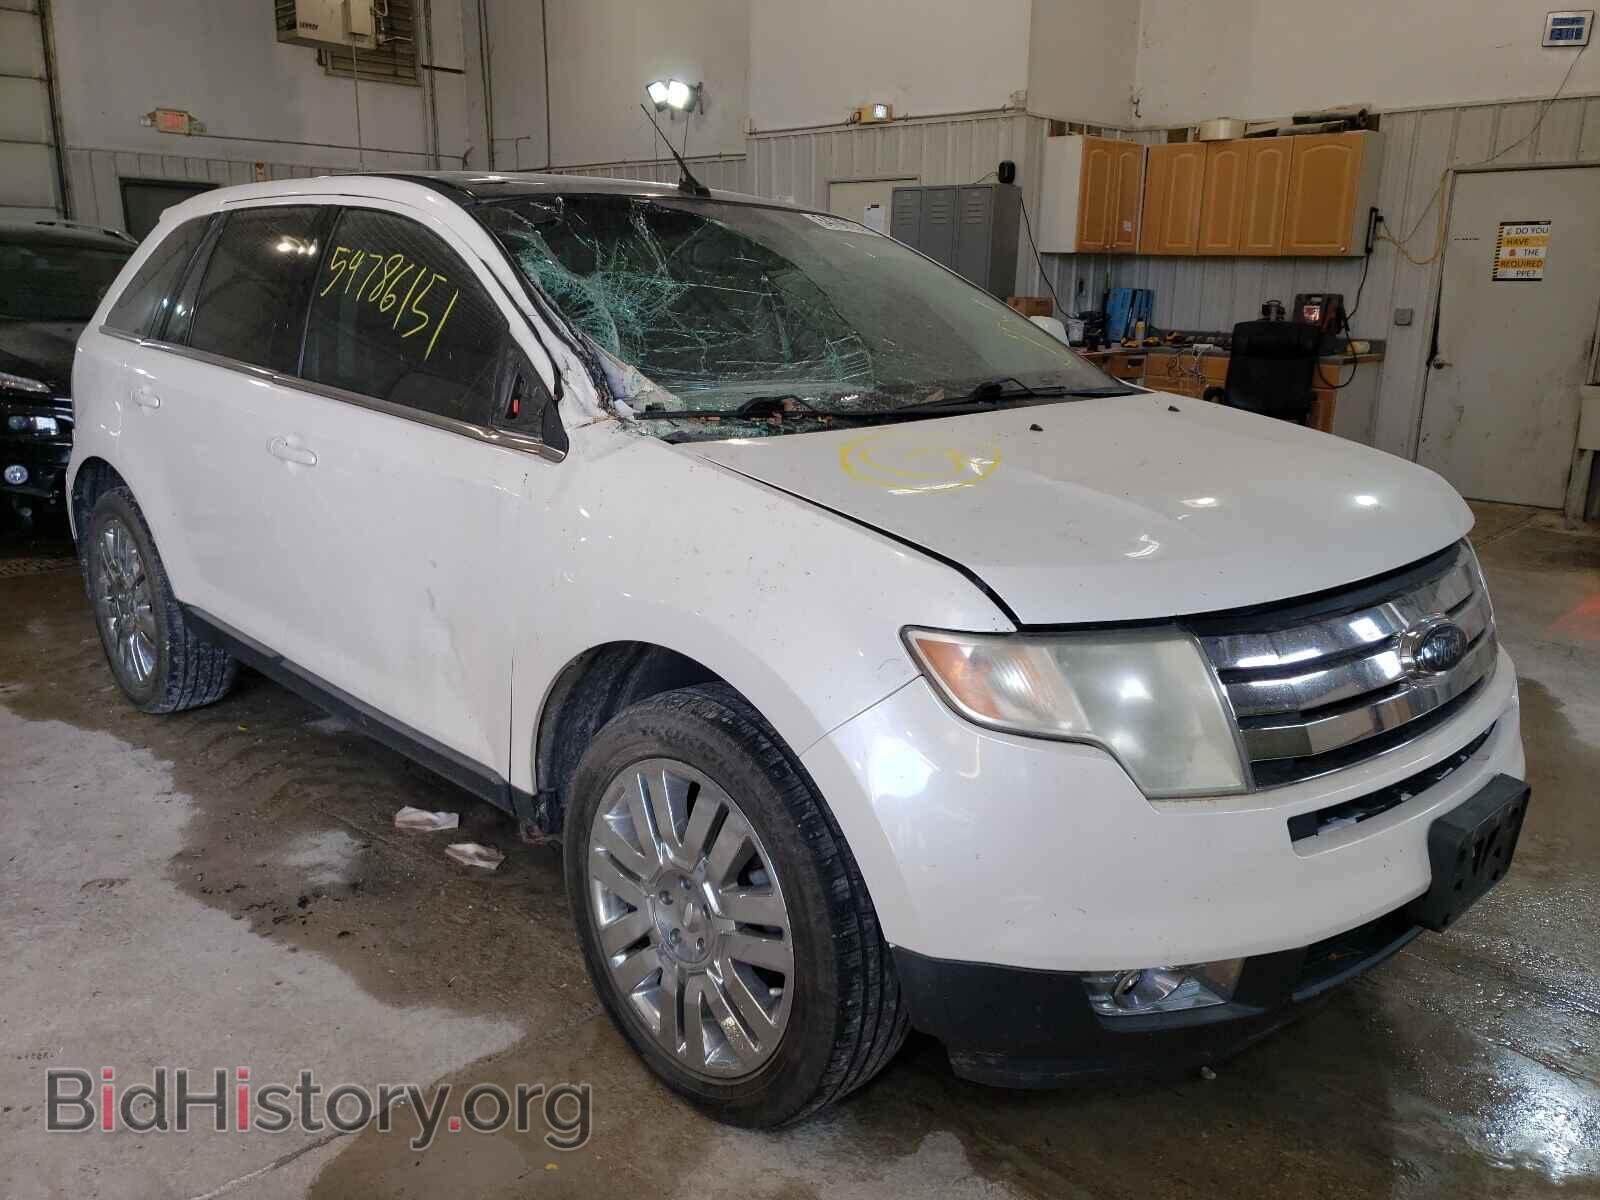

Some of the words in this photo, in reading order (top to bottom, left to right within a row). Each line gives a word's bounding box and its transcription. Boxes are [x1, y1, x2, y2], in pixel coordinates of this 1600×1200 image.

[1515, 227, 1529, 235] DO
[1530, 226, 1549, 234] YOU
[1506, 238, 1529, 246] HAVE
[1524, 248, 1540, 256] THE
[1500, 260, 1544, 268] REQUIRED
